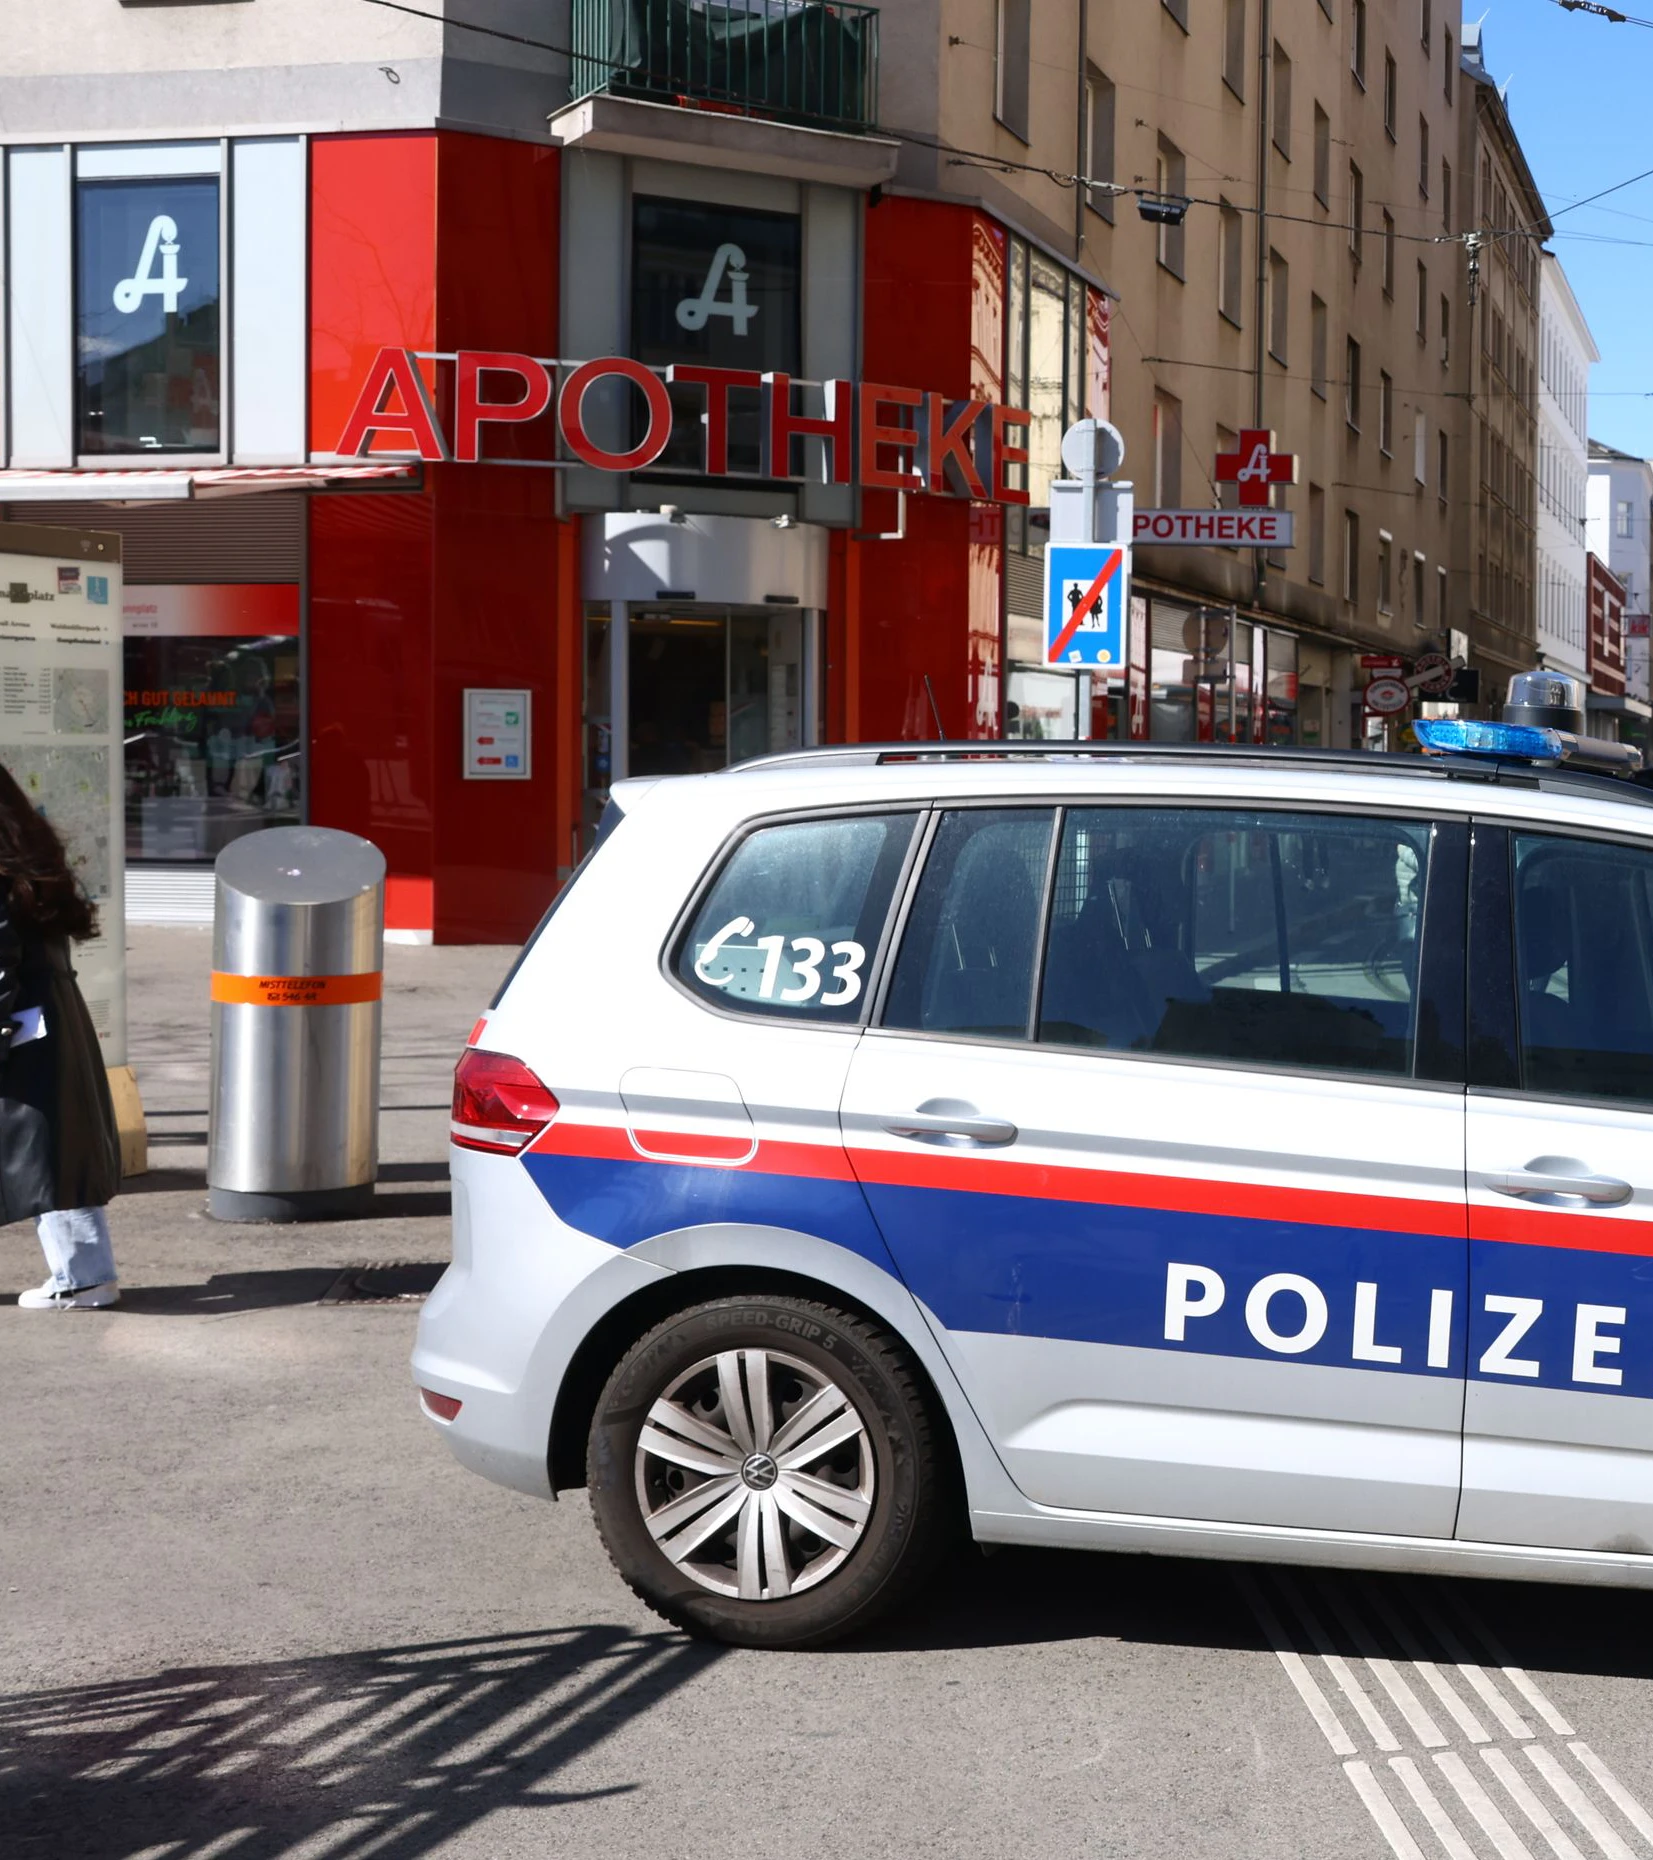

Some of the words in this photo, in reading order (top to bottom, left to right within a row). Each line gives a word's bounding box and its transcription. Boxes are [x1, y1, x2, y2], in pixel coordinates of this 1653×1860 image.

[336, 346, 1031, 506] APOTHEKE
[1133, 514, 1277, 541] POTHEKE
[141, 690, 169, 706] GUT
[172, 690, 237, 707] GELAUNT
[258, 980, 327, 990] MISTTELEFON
[758, 935, 866, 1006] 133
[705, 1310, 821, 1339] SPEED-GRIP
[822, 1334, 837, 1350] 5
